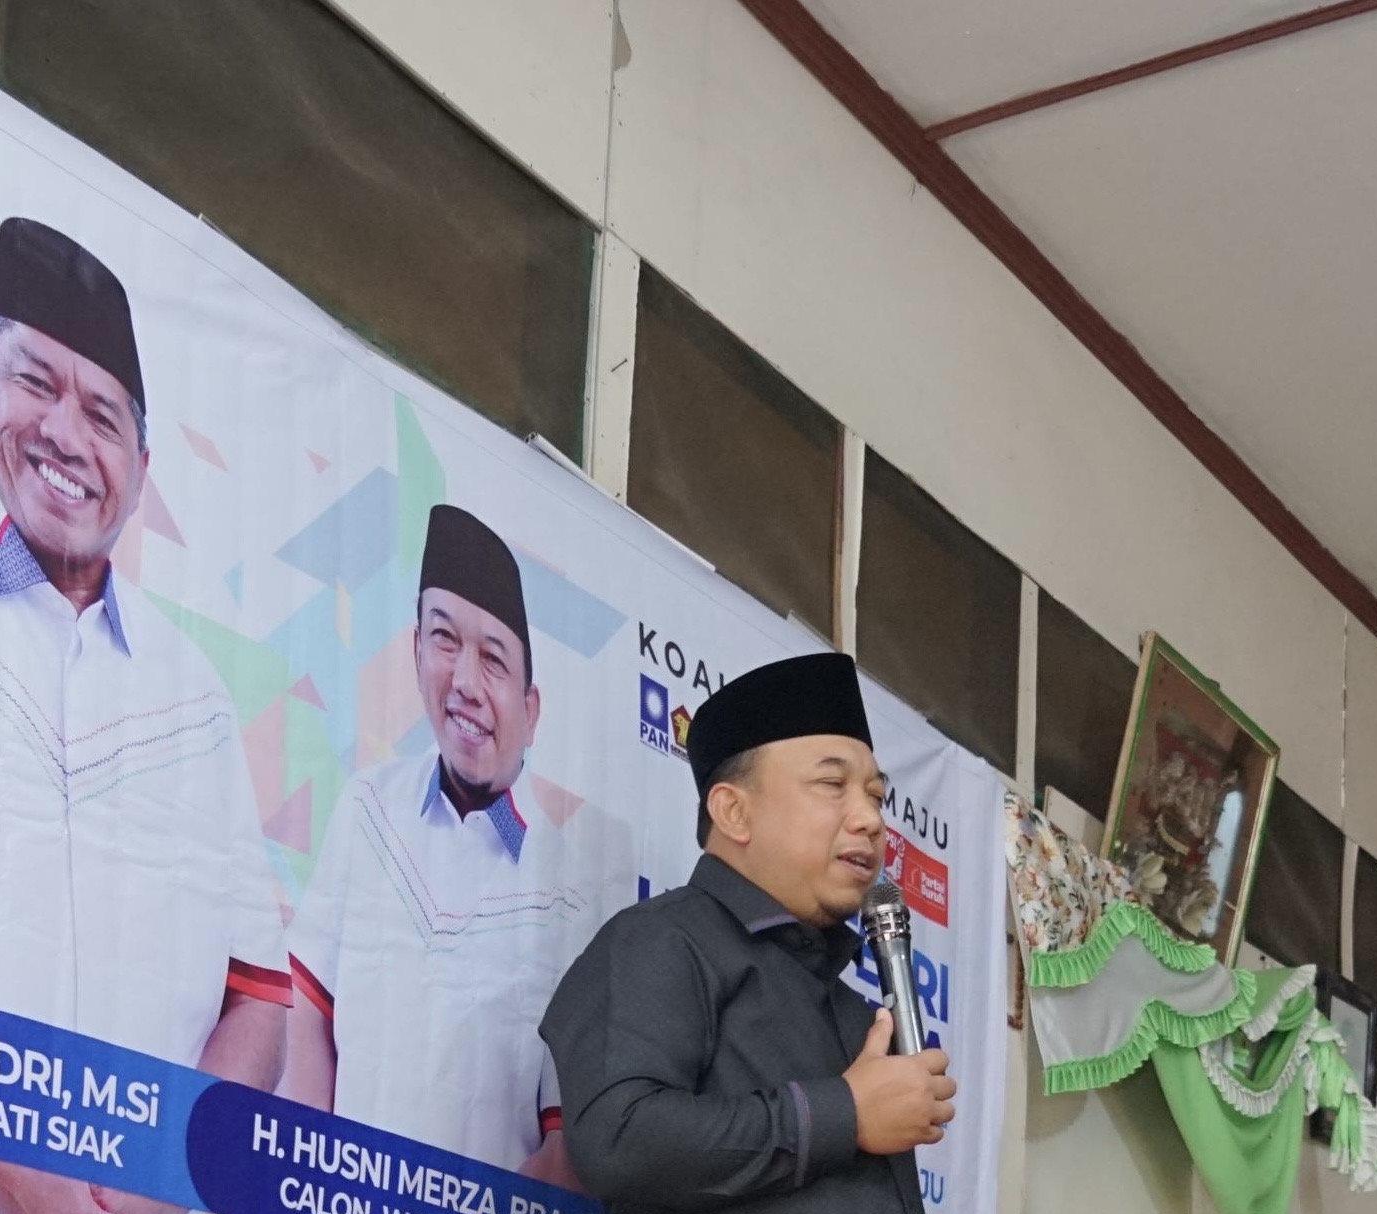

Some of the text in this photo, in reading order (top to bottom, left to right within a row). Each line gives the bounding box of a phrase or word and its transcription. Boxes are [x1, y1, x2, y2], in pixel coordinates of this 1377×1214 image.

[640, 721, 668, 752] PAN
[82, 1066, 159, 1127] M.Si
[47, 1116, 124, 1168] SIAK
[252, 1113, 285, 1159] H.
[293, 1126, 391, 1190] HUSNI
